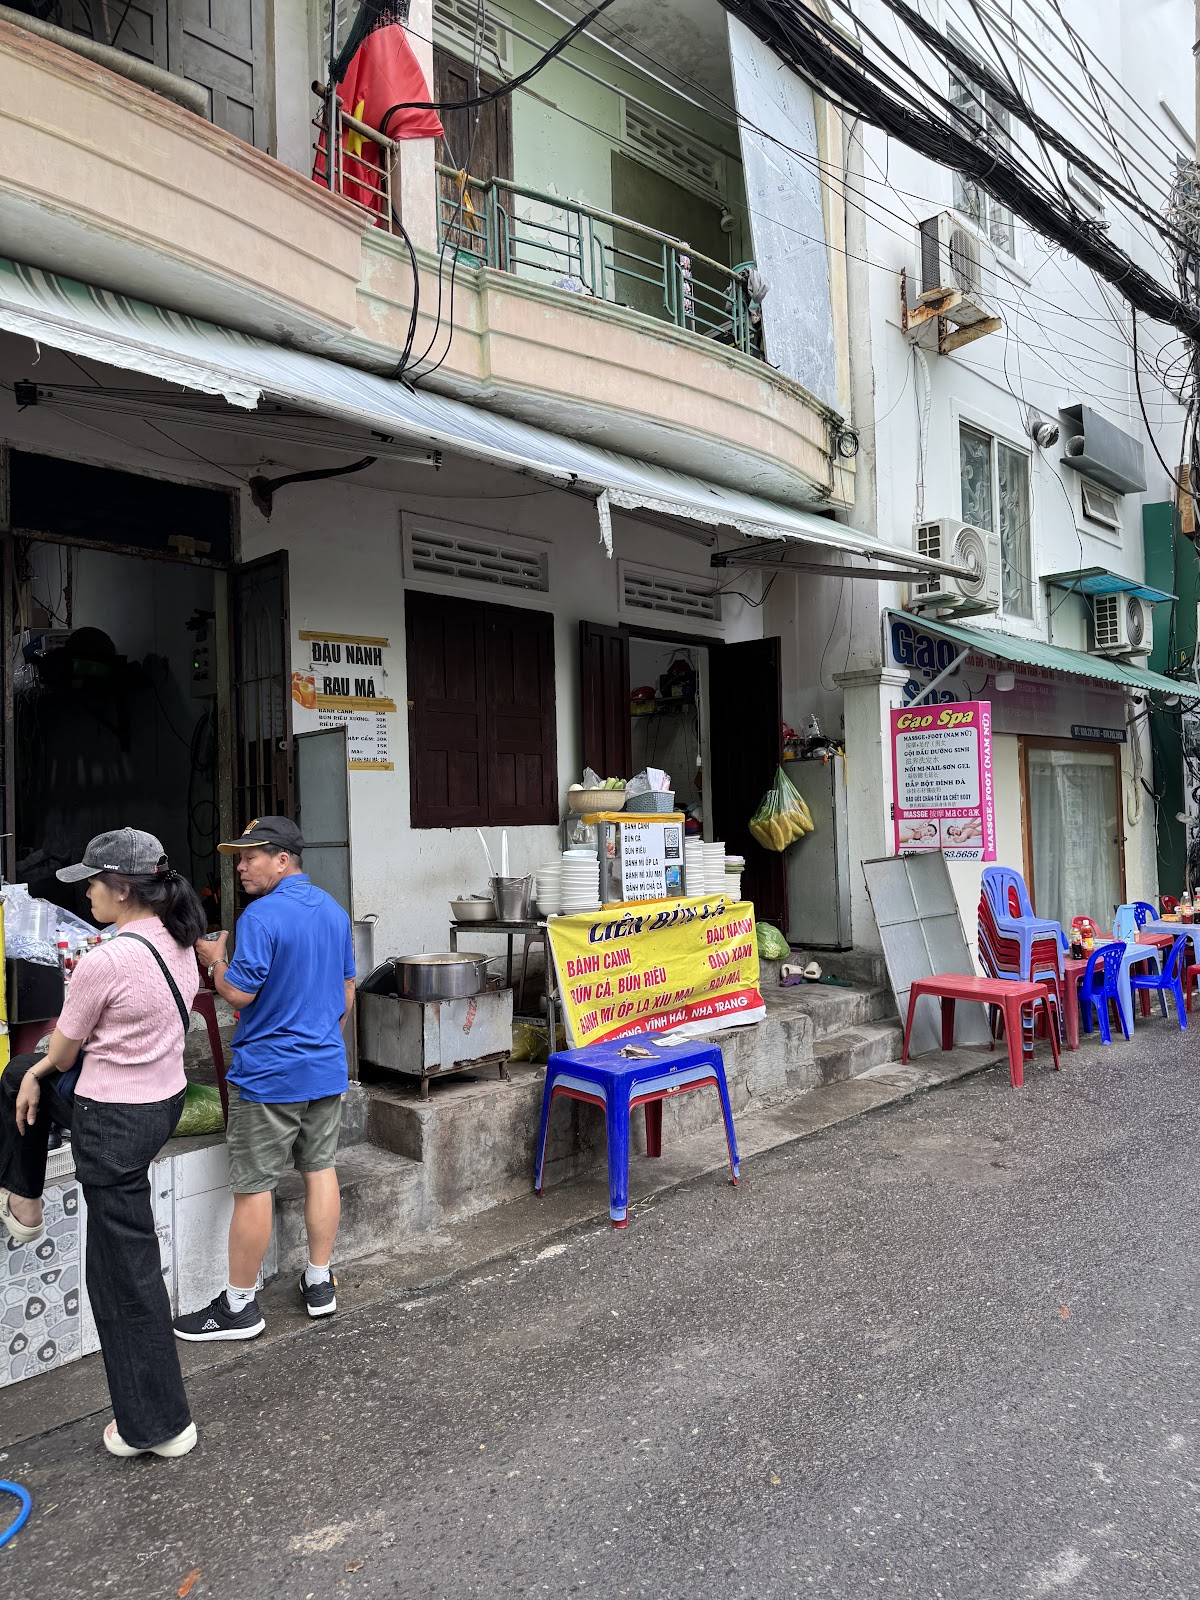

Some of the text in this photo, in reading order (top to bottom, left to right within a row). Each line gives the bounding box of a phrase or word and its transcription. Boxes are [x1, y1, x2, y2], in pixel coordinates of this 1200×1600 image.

[346, 643, 382, 666] NÀNH
[892, 622, 956, 678] Gạo
[323, 676, 376, 698] RAU MÁ
[896, 709, 974, 732] Gạo Spa
[984, 771, 994, 852] MASSGE+FOOT
[625, 858, 638, 867] BÁNH
[639, 857, 644, 866] MÌ
[626, 870, 638, 880] BÁNH
[626, 882, 638, 892] BÁNH
[640, 882, 645, 891] MÌ
[588, 912, 650, 944] LIÊN
[650, 904, 698, 932] BÚN
[706, 918, 753, 946] ĐẬU NÀNH
[567, 948, 632, 978] BÁNH CANH
[708, 950, 729, 970] ĐẬU
[570, 966, 667, 1006] BÚN CÁ, BÚN RIÊU
[707, 968, 741, 992] RAU MÁ
[580, 986, 695, 1036] BÁNH MÌ ỐP LA XÍU MẠI
[645, 1018, 668, 1032] VĨNH
[670, 1009, 688, 1024] HẢI,
[691, 1005, 713, 1018] NHA
[715, 996, 748, 1014] TRANG
